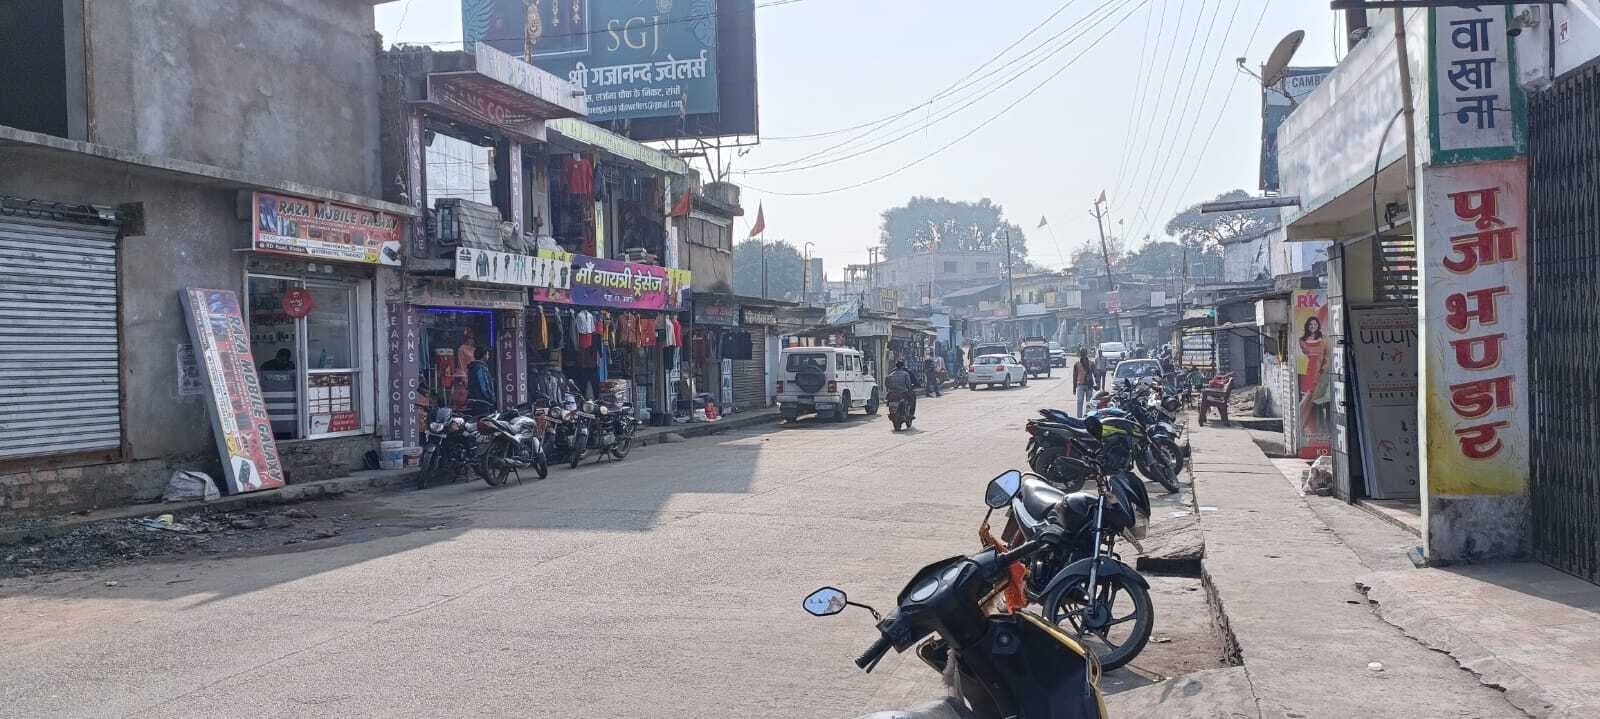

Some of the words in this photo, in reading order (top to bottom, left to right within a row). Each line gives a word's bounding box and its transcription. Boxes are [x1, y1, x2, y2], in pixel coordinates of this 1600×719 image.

[607, 16, 660, 55] SGJ
[568, 62, 588, 88] श्री
[591, 63, 653, 86] गजानन्द
[654, 49, 707, 81] ज्वेलर्स
[1292, 75, 1322, 88] CAMB
[1448, 6, 1498, 129] वाखाना
[279, 200, 310, 217] RAZA
[314, 205, 357, 224] MOBILE
[360, 214, 397, 230] GALAXY
[1443, 186, 1518, 274] पूजा
[576, 262, 594, 285] माँ
[594, 267, 632, 289] गायत्री
[1296, 294, 1320, 308] RK
[391, 303, 399, 364] JEANS
[407, 304, 415, 363] JEANS
[229, 315, 249, 353] RAZA
[240, 359, 266, 419] MOBILE
[257, 423, 282, 482] GALAXY
[392, 378, 401, 439] CORNE
